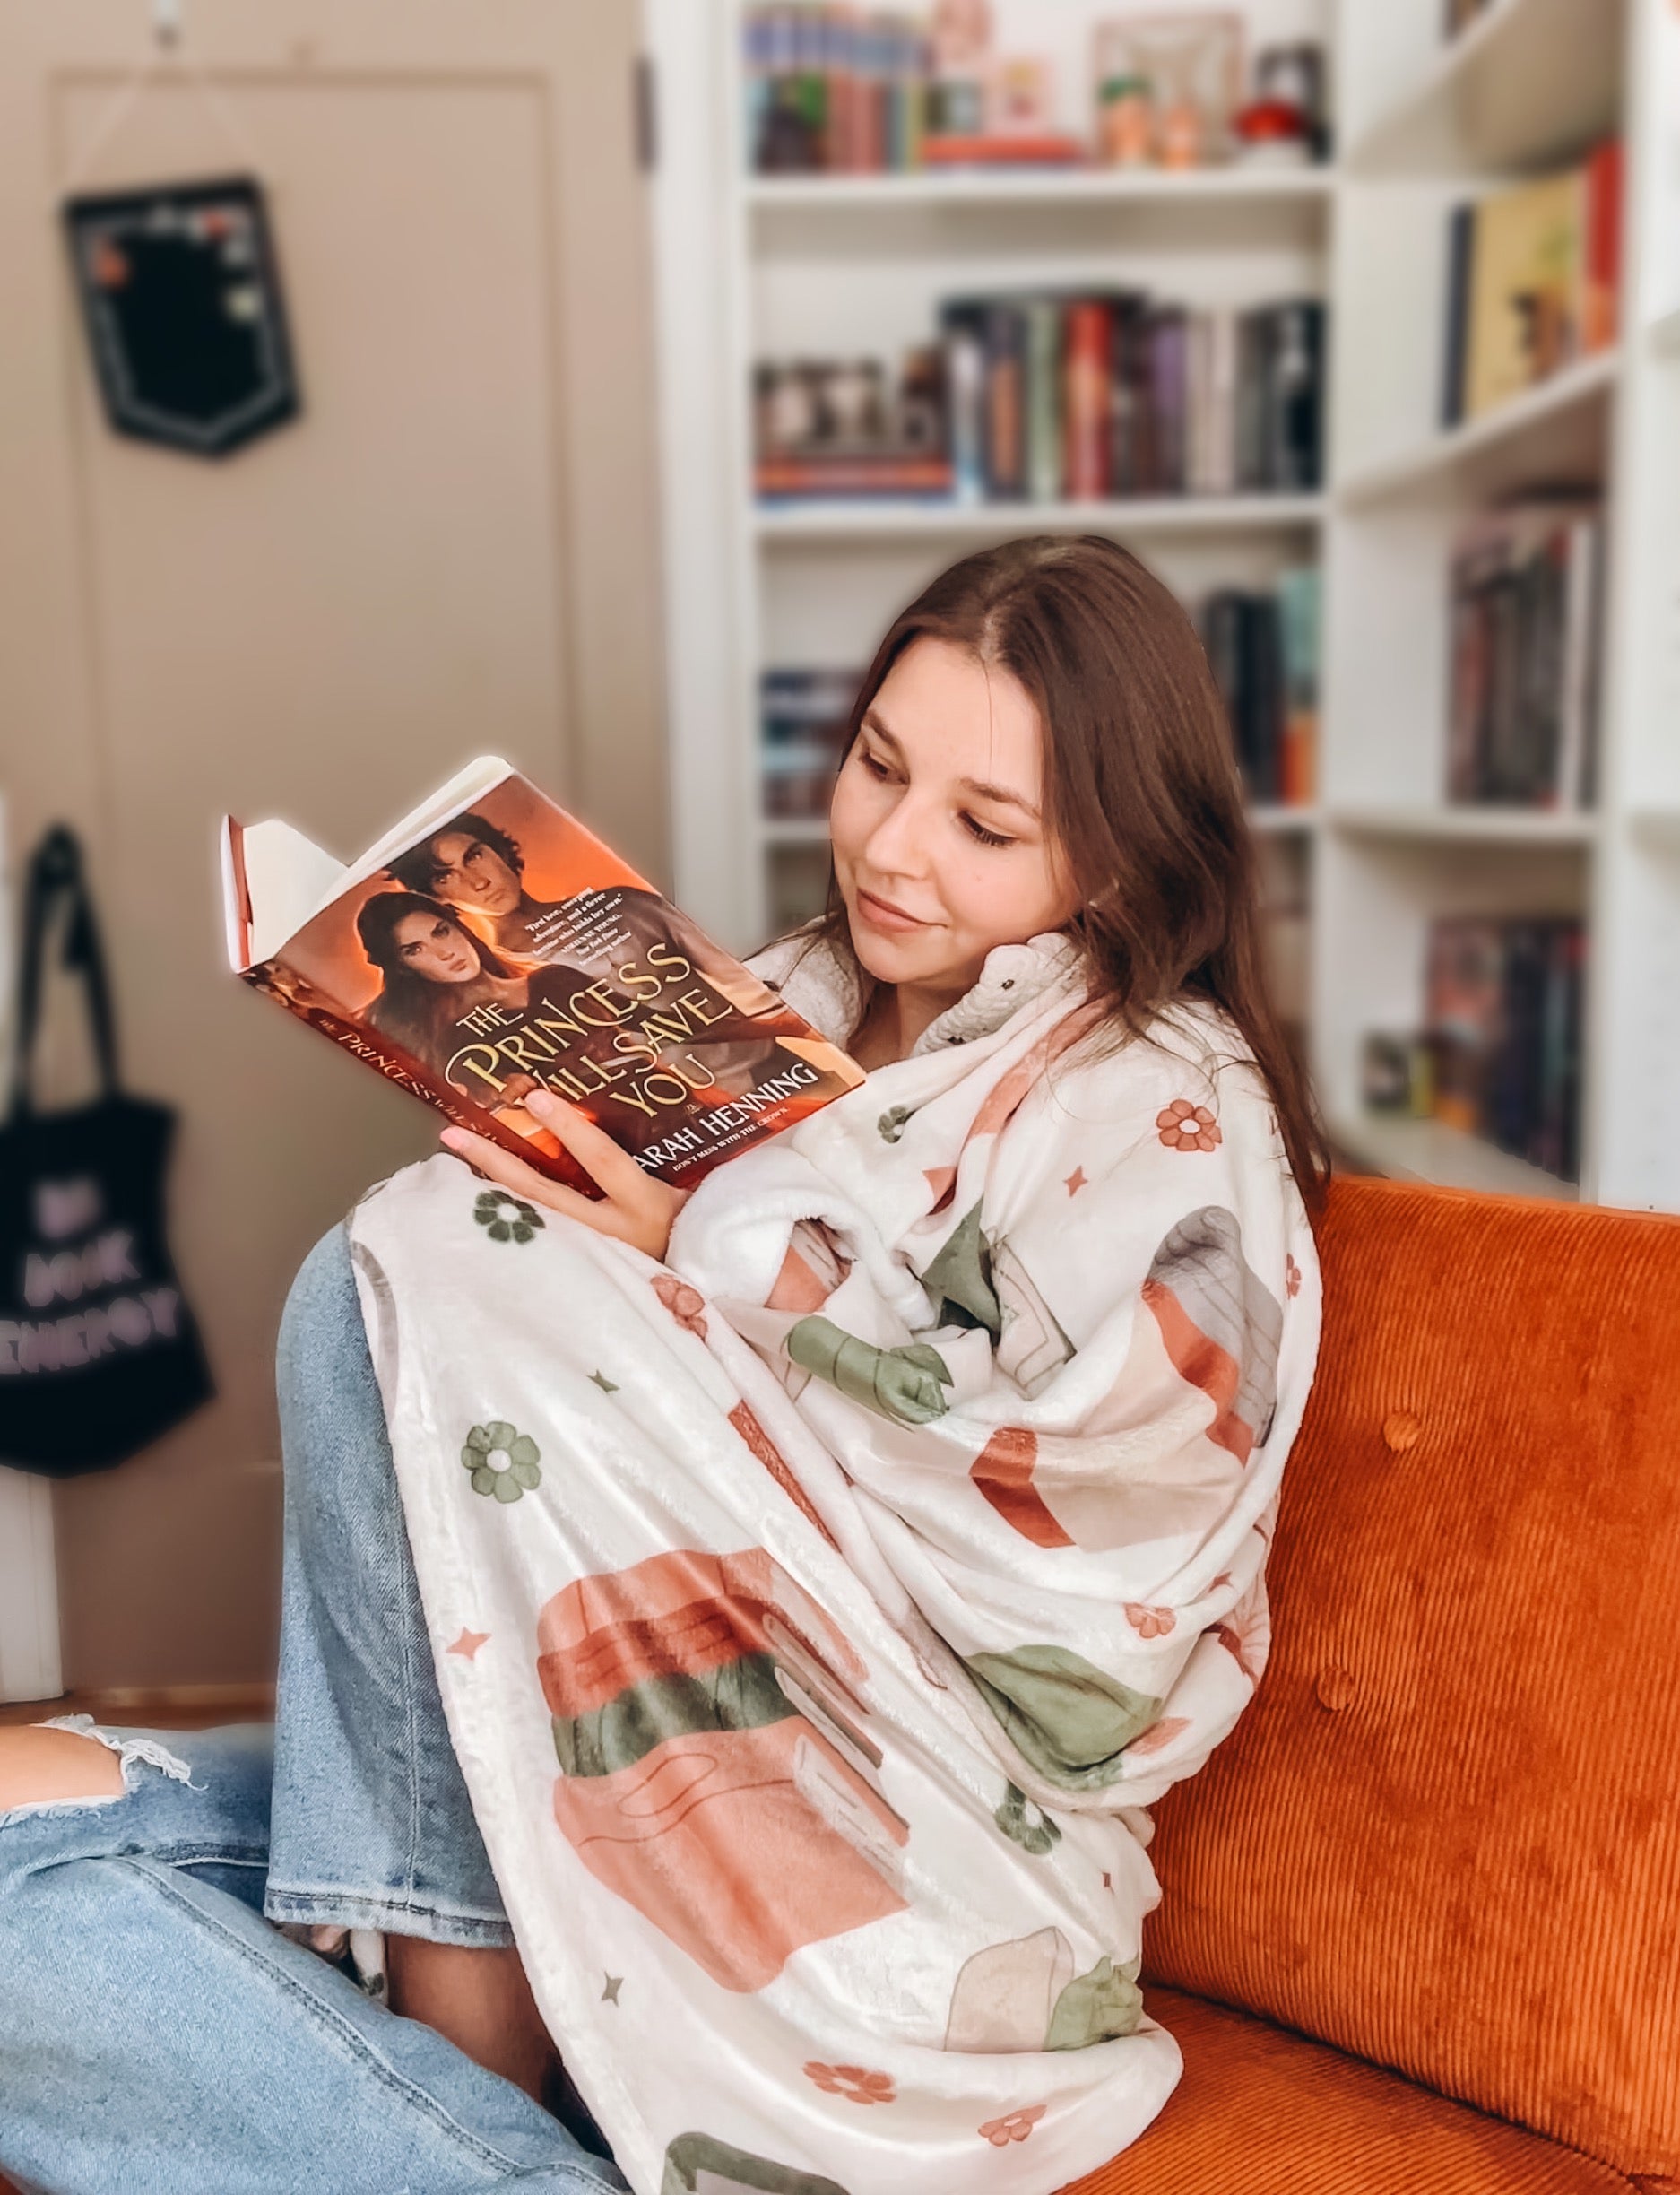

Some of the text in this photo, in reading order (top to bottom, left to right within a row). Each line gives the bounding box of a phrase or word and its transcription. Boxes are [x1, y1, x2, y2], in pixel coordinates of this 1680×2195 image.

[445, 942, 690, 1093] PRINCESS
[455, 1002, 524, 1037] THE
[612, 988, 733, 1075] SAVE
[338, 1032, 437, 1101] PRINCESS
[608, 1053, 716, 1118] YOU
[632, 1063, 819, 1169] ARAH HENNING
